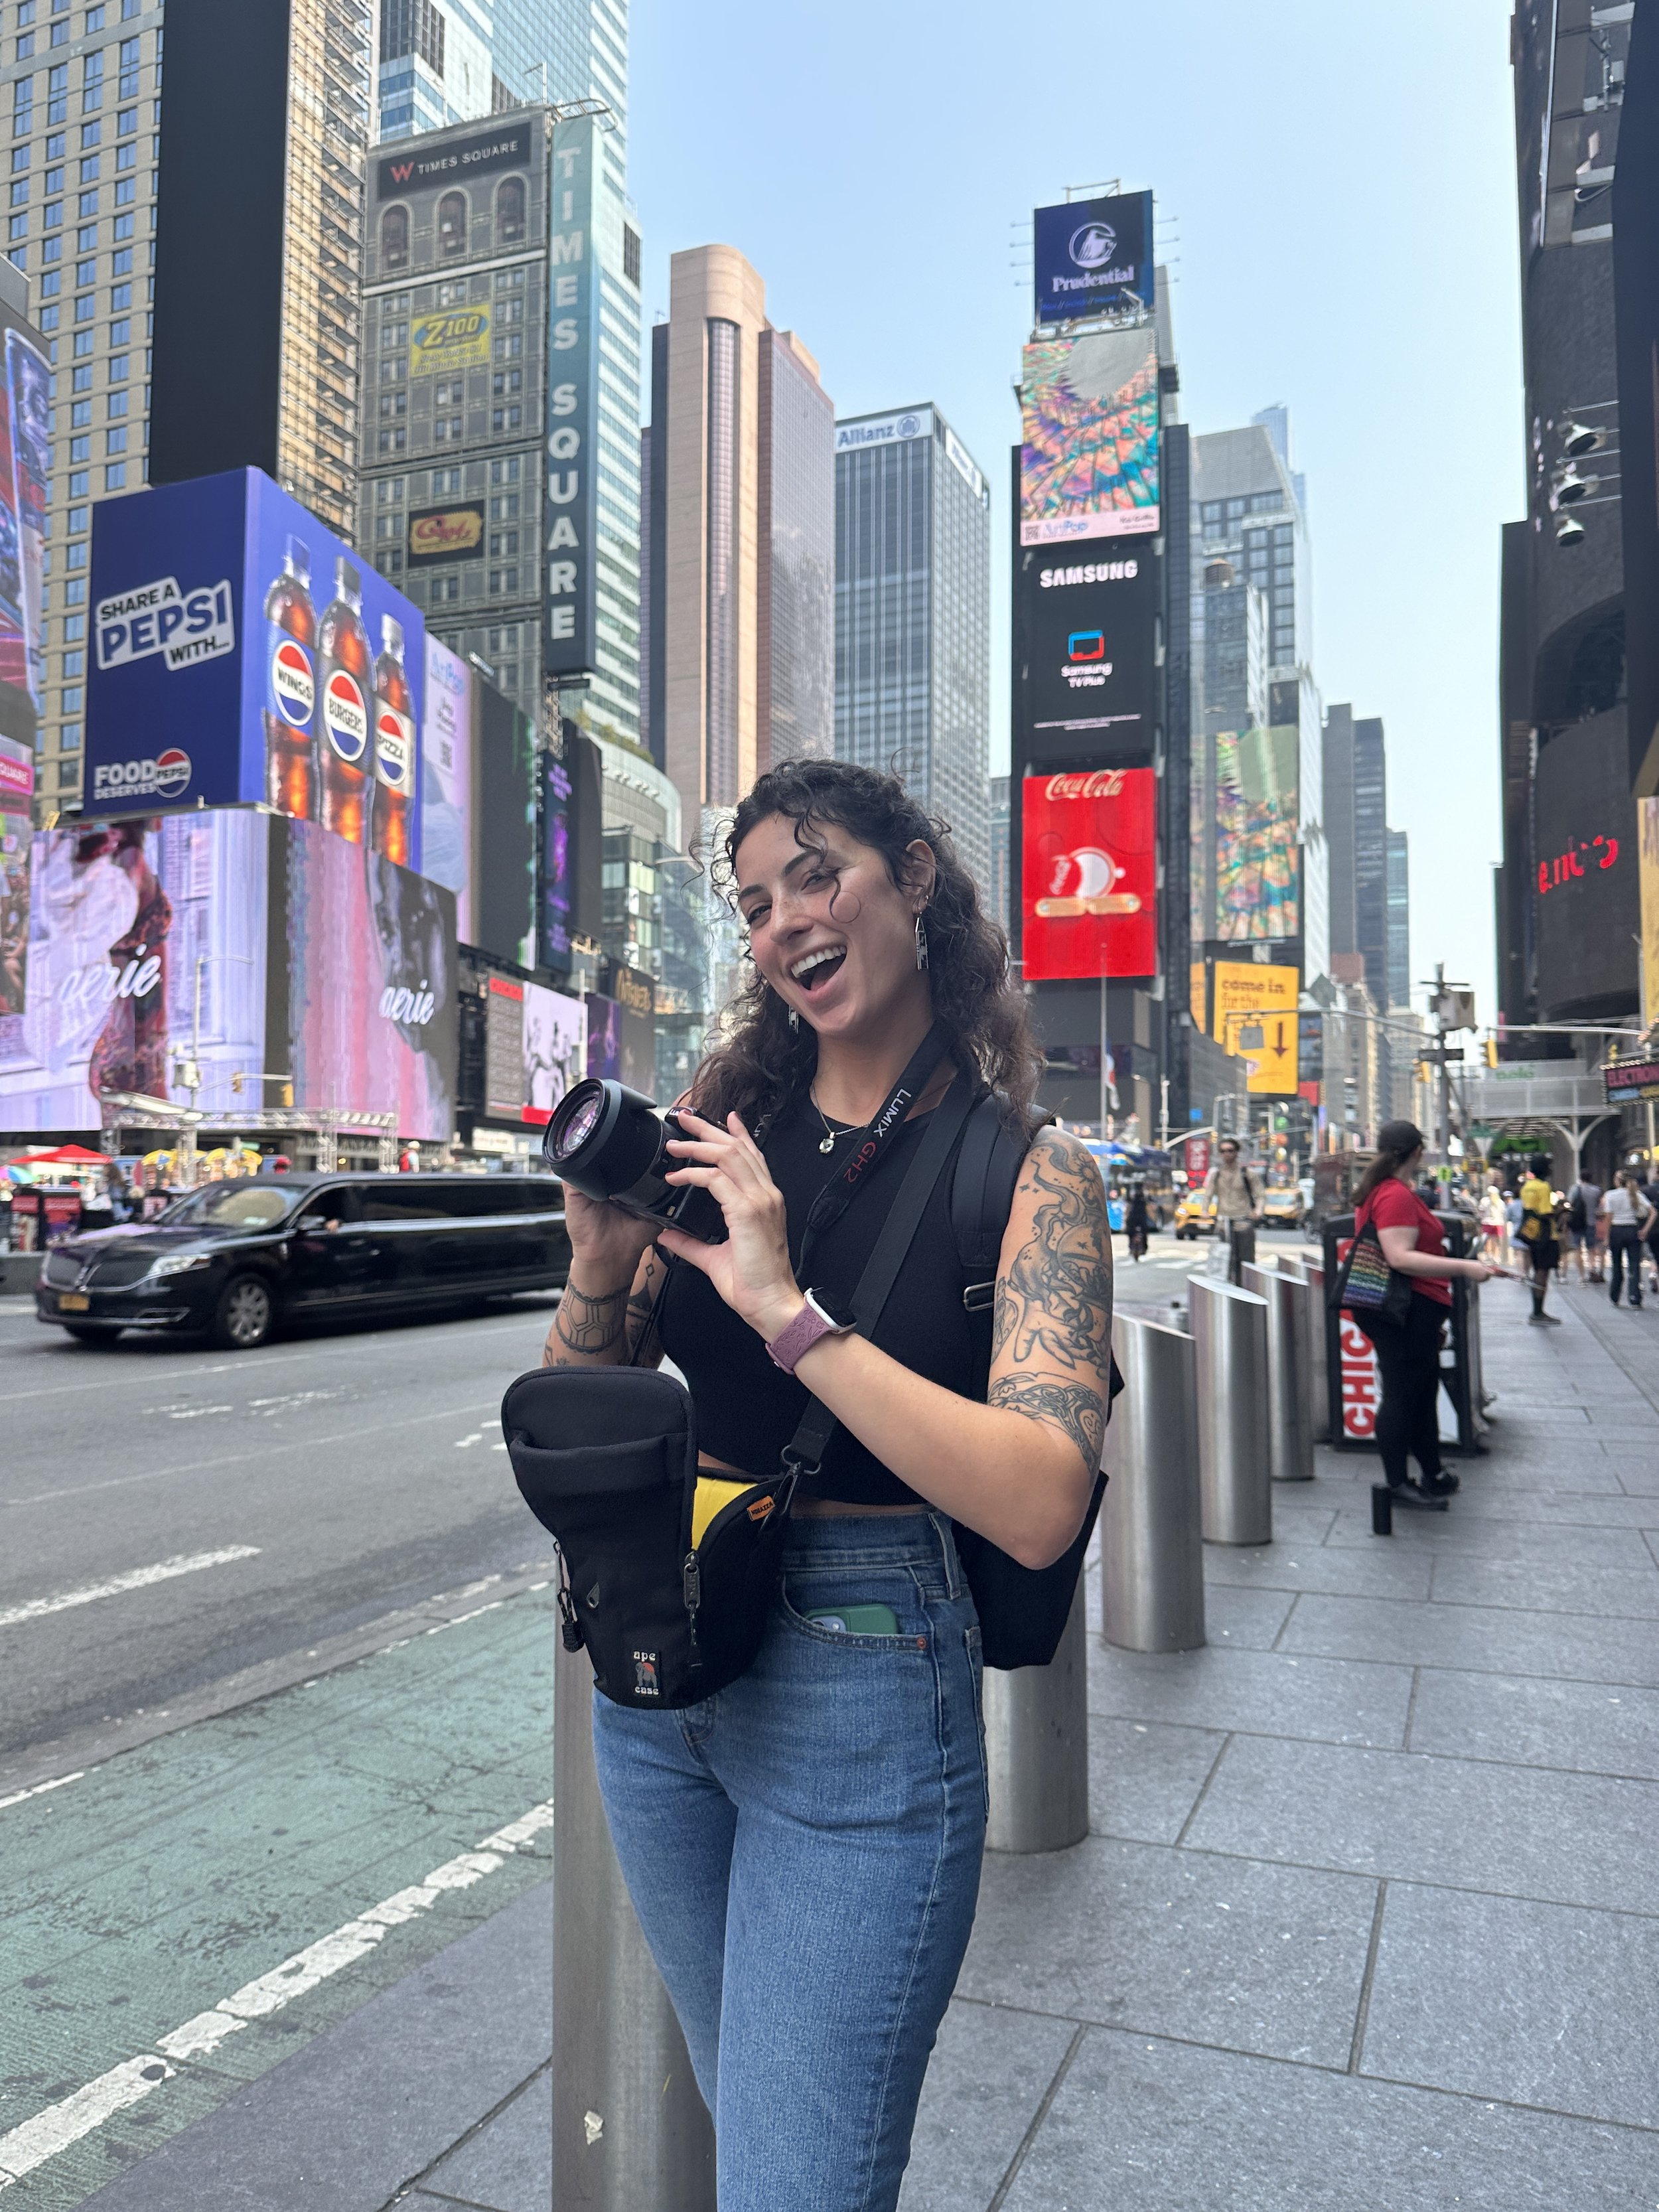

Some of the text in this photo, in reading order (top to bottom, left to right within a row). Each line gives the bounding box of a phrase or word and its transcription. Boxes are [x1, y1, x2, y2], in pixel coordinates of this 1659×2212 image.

[390, 139, 519, 184] W TIMES SQUARE
[1052, 264, 1135, 292] Prudential
[423, 315, 481, 348] Z100
[547, 146, 584, 640] TIMES SQUARE
[837, 423, 895, 448] Allianz
[1040, 559, 1139, 588] SAMSUNG
[101, 584, 175, 622] SHARE A
[102, 589, 228, 664] PEPSI
[277, 666, 313, 700] WINGS
[1061, 662, 1113, 677] Samsung
[1068, 676, 1106, 688] TV Plus
[328, 698, 363, 733] BURGERS
[377, 735, 403, 760] PIZZA
[94, 759, 157, 788] FOOD
[157, 767, 188, 778] PEPSI
[94, 782, 158, 800] DESERVES
[58, 943, 161, 1002] aerie
[1222, 977, 1286, 994] come in
[378, 978, 435, 1025] aerie
[843, 1088, 912, 1183] LUMIX GH2
[633, 1651, 656, 1662] ape
[634, 1686, 659, 1696] case
